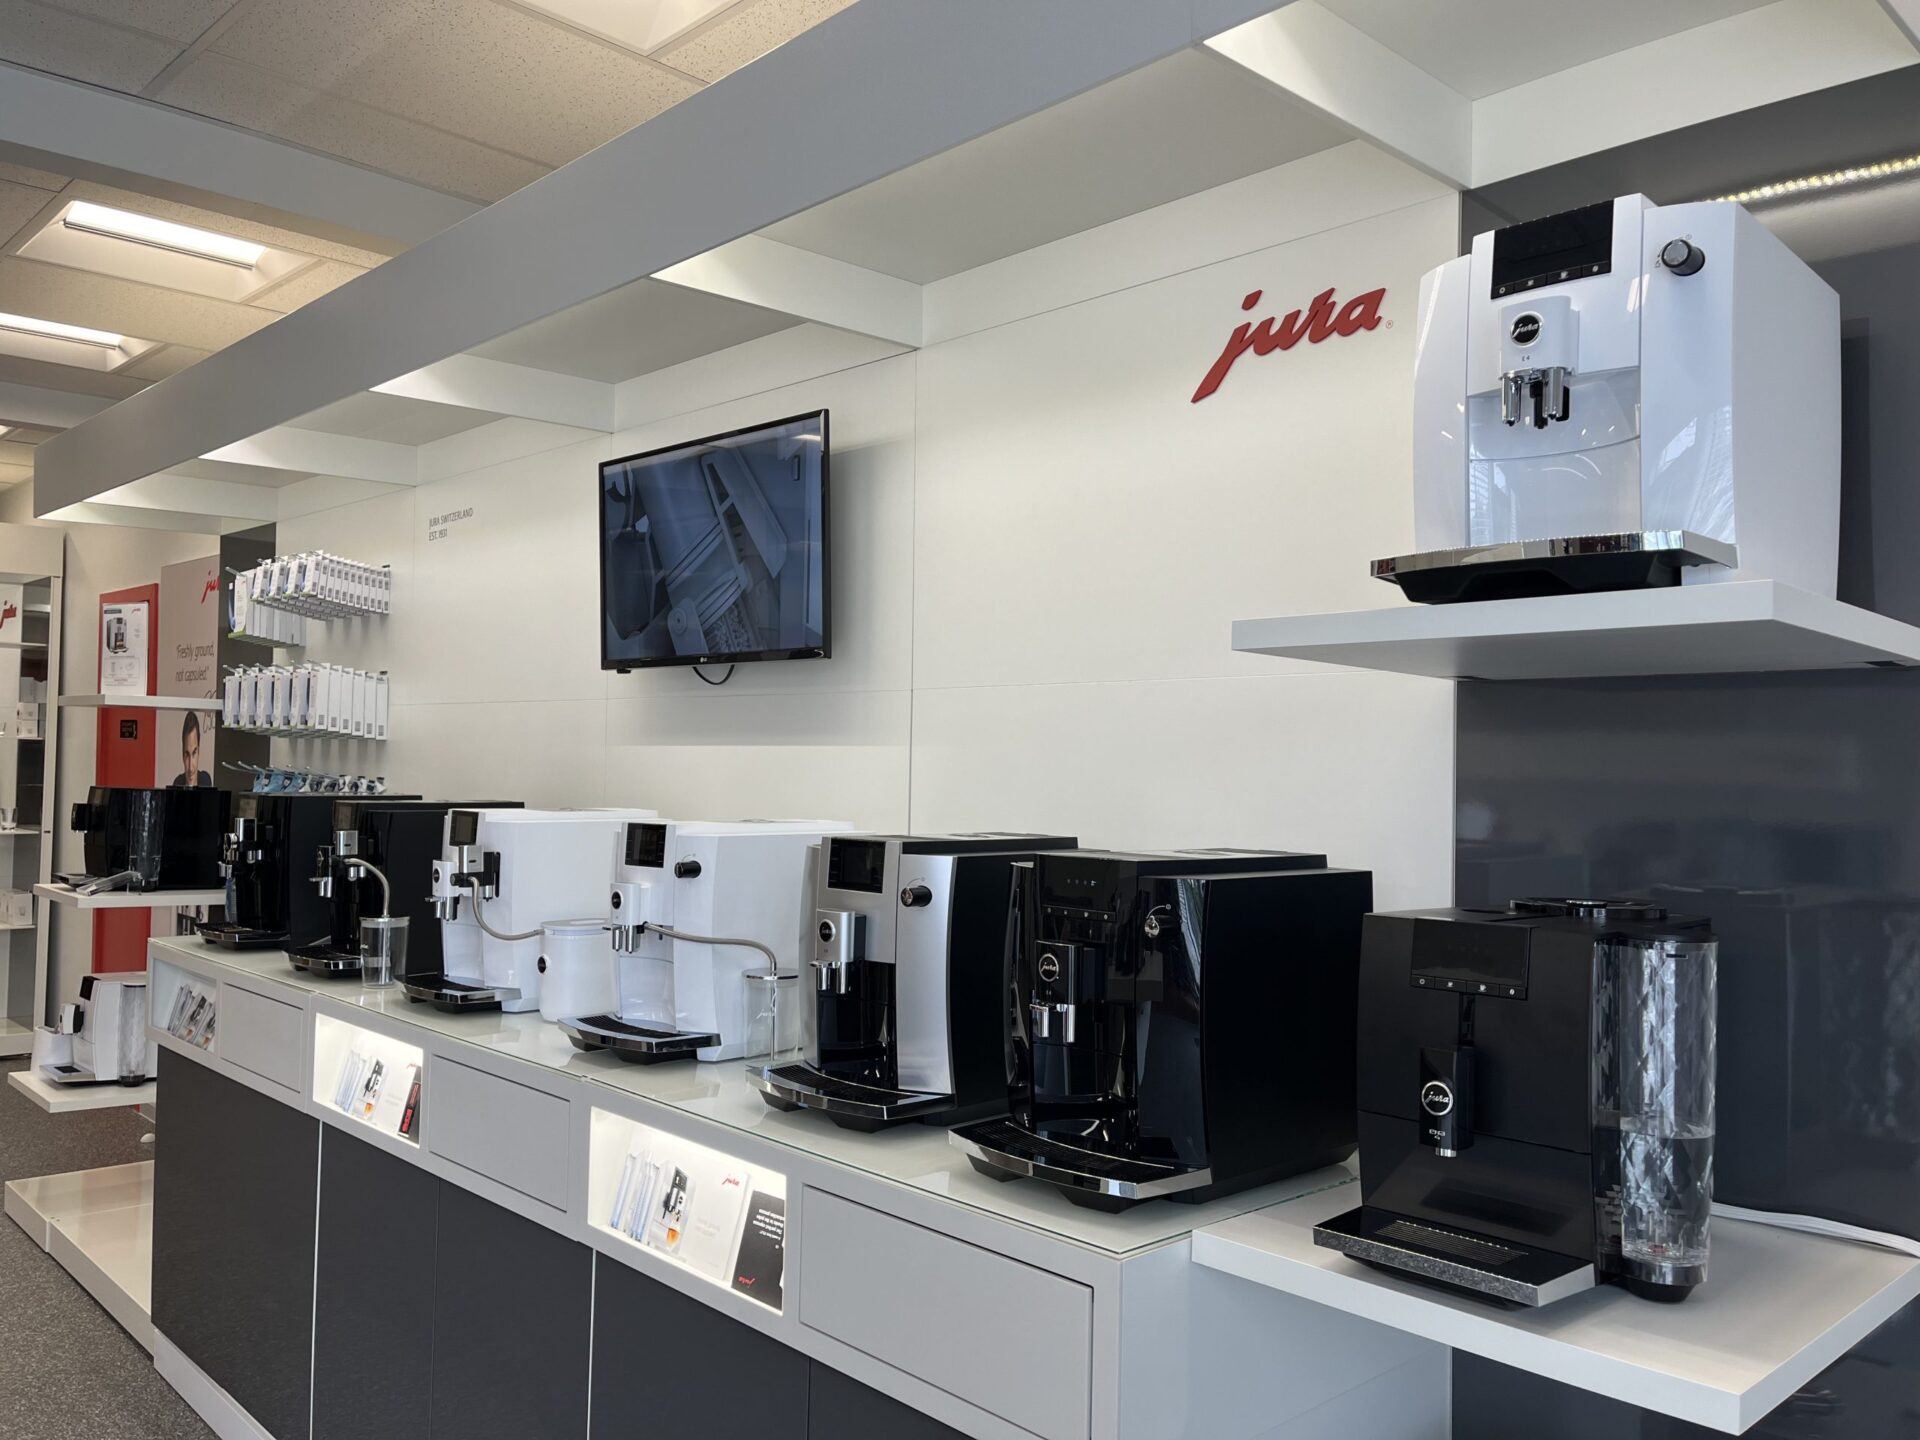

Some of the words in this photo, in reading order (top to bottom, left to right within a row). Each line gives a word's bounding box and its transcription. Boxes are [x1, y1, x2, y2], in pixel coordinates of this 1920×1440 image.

[1511, 323, 1538, 338] jura
[1190, 287, 1386, 404] jura
[429, 517, 440, 530] JURA
[440, 507, 473, 525] SWITZERLAND
[438, 528, 448, 539] 1931
[1040, 961, 1057, 972] jura
[1425, 1091, 1449, 1103] jura
